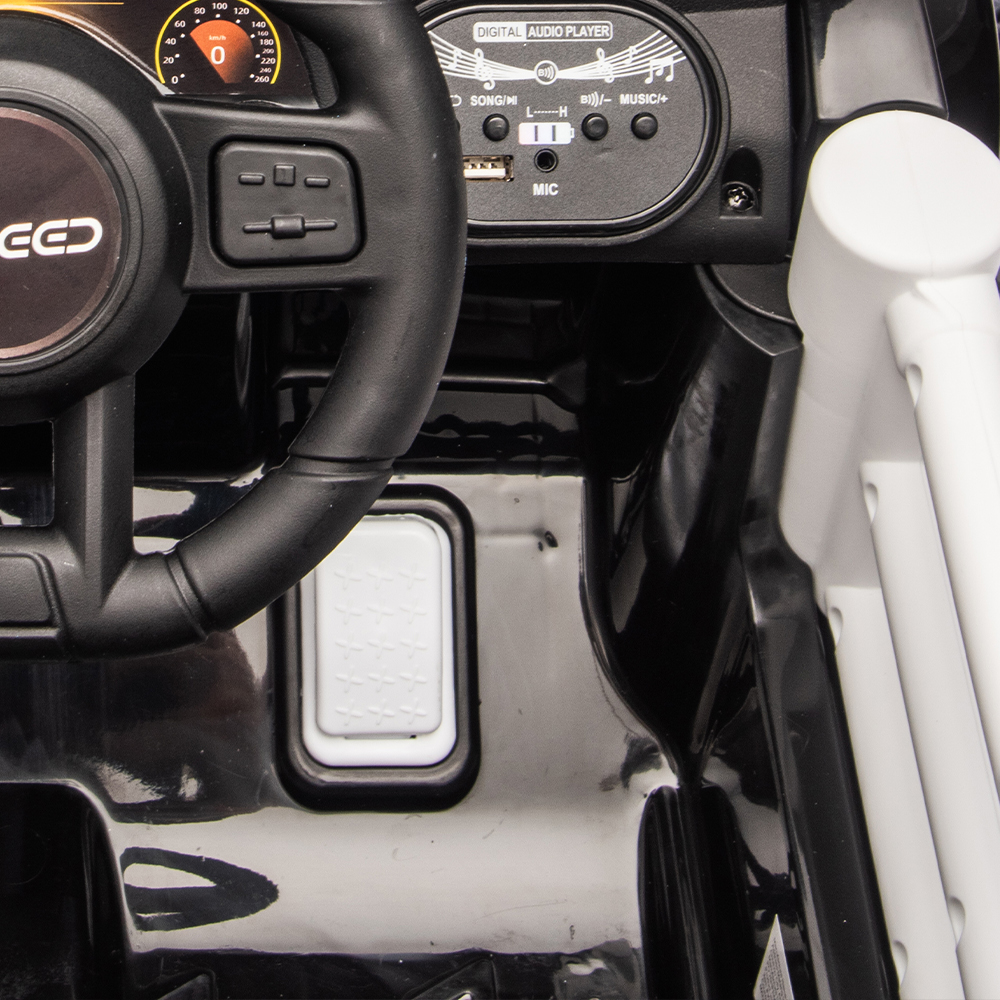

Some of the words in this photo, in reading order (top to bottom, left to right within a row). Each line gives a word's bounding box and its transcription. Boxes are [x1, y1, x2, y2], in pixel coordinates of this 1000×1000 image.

[194, 6, 206, 15] 80
[212, 2, 228, 10] 100
[233, 7, 250, 15] 120
[174, 19, 186, 28] 60
[251, 21, 267, 29] 140
[477, 26, 523, 38] DIGITAL
[527, 25, 563, 37] AUDIO
[565, 25, 610, 37] PLAYER
[165, 36, 177, 45] 40
[260, 38, 274, 46] 180
[163, 55, 174, 65] 20
[210, 46, 226, 65] 0
[260, 57, 276, 65] 220
[171, 75, 179, 85] 0
[254, 75, 270, 83] 260
[532, 183, 559, 196] MIC
